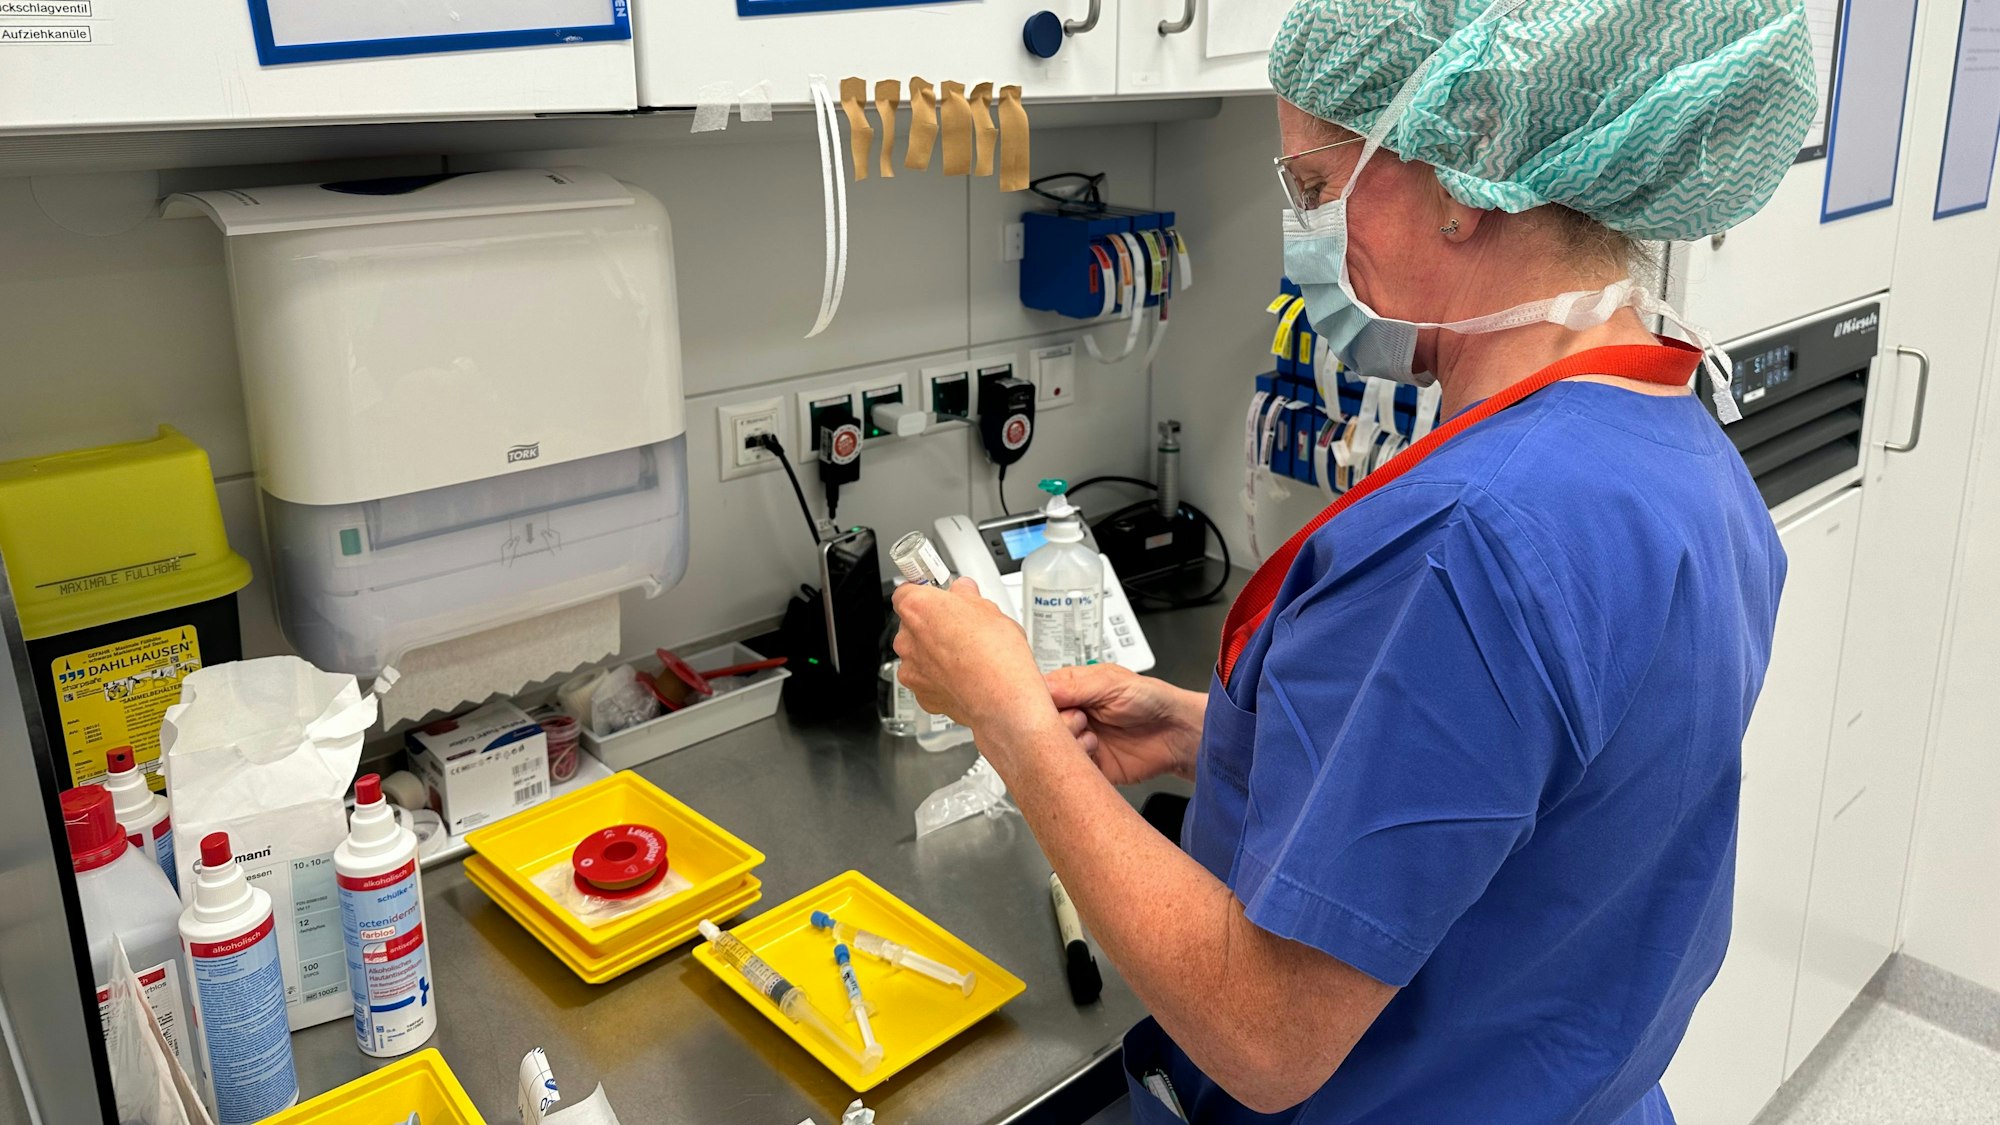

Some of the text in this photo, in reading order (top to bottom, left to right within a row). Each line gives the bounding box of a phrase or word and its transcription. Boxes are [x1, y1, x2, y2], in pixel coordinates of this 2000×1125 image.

[0, 3, 87, 15] ckschlagventil
[2, 29, 87, 39] Aufziehkanüle
[508, 447, 538, 462] TORK
[60, 573, 119, 596] MAXIMALE
[1034, 596, 1062, 607] NaCl
[62, 677, 102, 691] sharpsafe
[626, 826, 662, 865] Leukoplast
[294, 860, 305, 870] 10
[310, 857, 322, 867] 10
[363, 869, 408, 888] alkoholisch
[377, 887, 409, 903] schülke
[299, 918, 310, 927] 12
[361, 928, 395, 940] farblos
[212, 930, 262, 955] alkoholisch
[303, 962, 319, 972] 100
[368, 959, 412, 974] Alkoholisches
[318, 986, 339, 997] 10022
